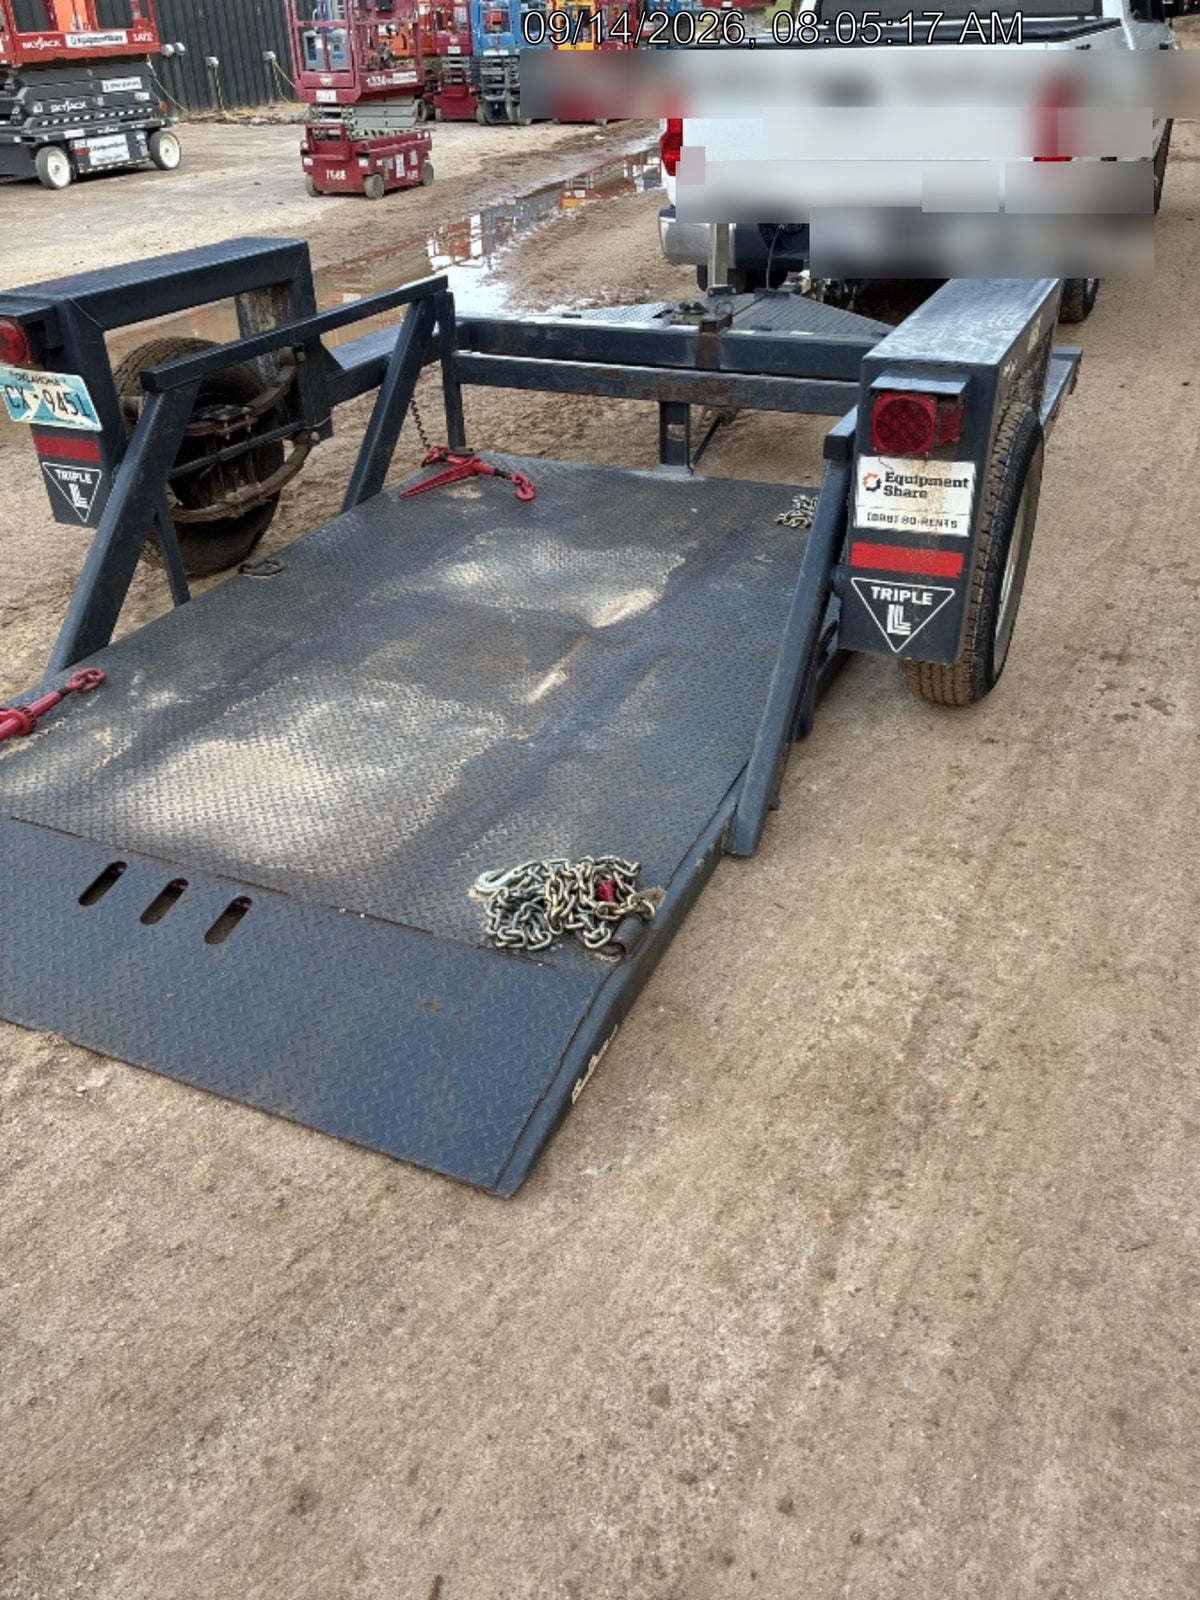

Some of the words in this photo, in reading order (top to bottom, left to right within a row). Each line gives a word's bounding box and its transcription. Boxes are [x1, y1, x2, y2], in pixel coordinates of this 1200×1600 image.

[54, 469, 93, 484] TRIPLE
[884, 470, 969, 488] Equipment
[884, 485, 928, 498] Share
[870, 586, 934, 606] TRIPLE
